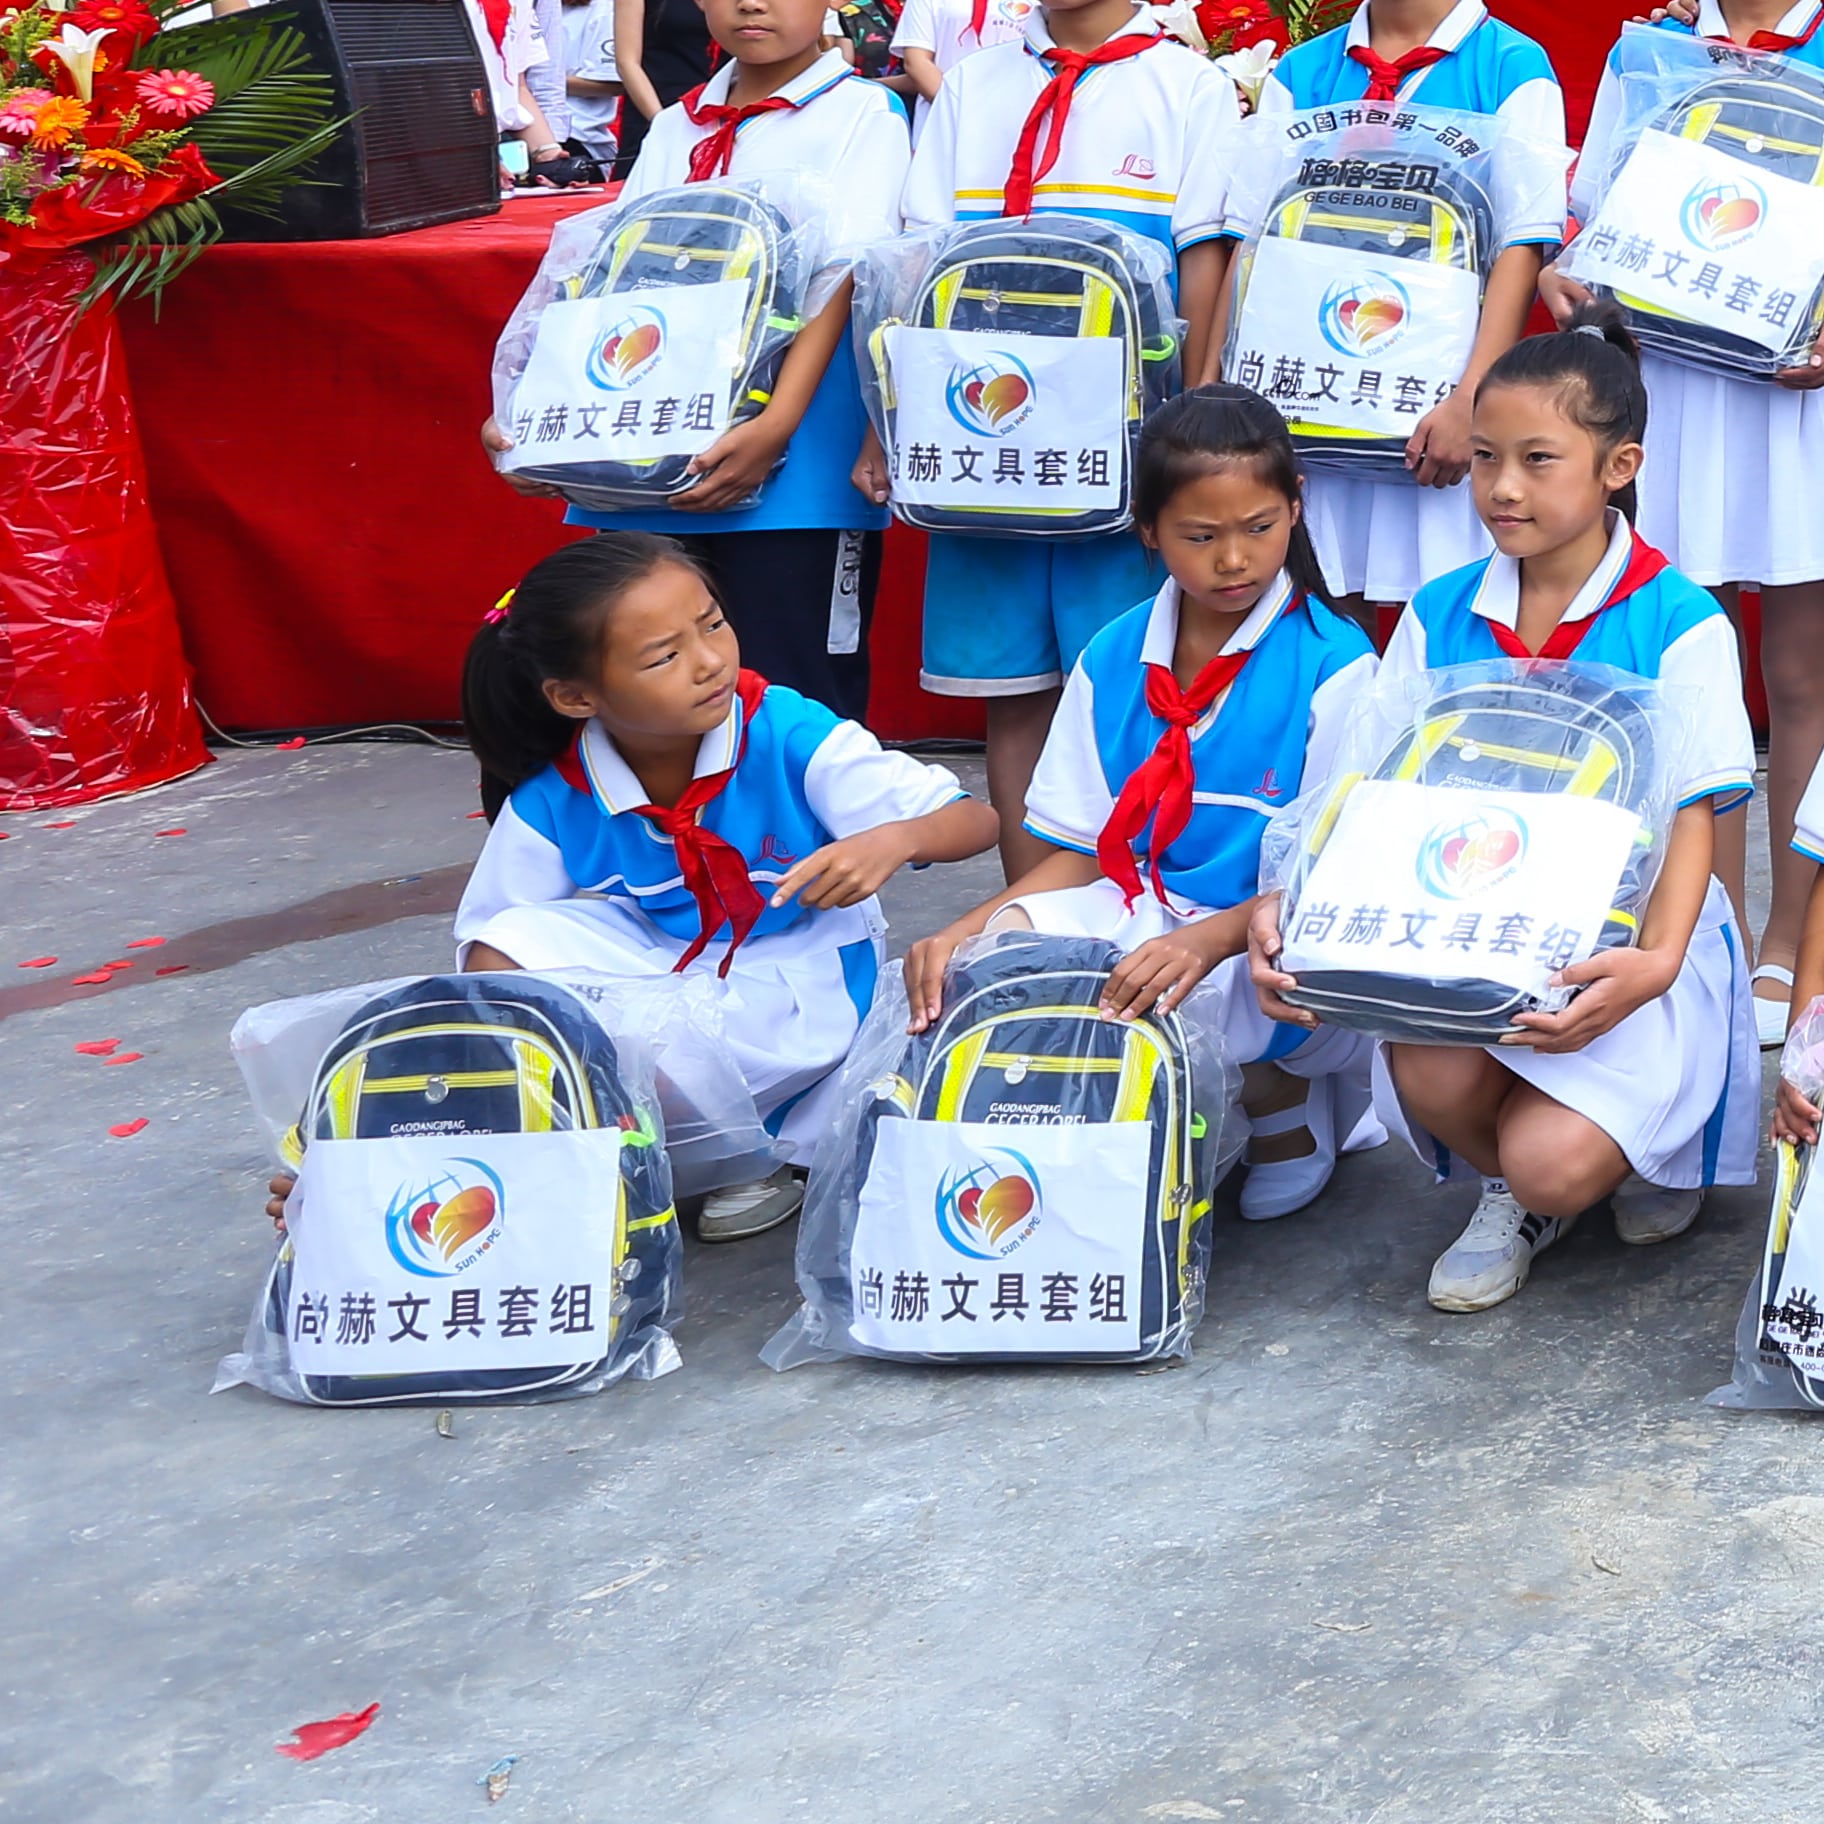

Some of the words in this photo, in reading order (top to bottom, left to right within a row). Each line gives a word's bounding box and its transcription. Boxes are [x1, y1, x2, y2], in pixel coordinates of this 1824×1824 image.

[1287, 109, 1482, 159] 中国书包第一品牌
[1298, 157, 1439, 191] 格格宝贝
[1304, 192, 1325, 204] GE
[1328, 193, 1351, 205] GE
[1353, 194, 1388, 208] BAO
[1391, 197, 1417, 211] BEI
[1585, 222, 1797, 328] 尚赫文具套组
[1293, 902, 1584, 970] 尚赫文具套组
[455, 1253, 476, 1272] SUN
[475, 1228, 501, 1257] HOPE
[1000, 1237, 1020, 1257] SUN
[1019, 1215, 1041, 1242] HOPE
[294, 1283, 596, 1345] 尚赫文具套组
[857, 1267, 1129, 1323] 尚赫文具套组
